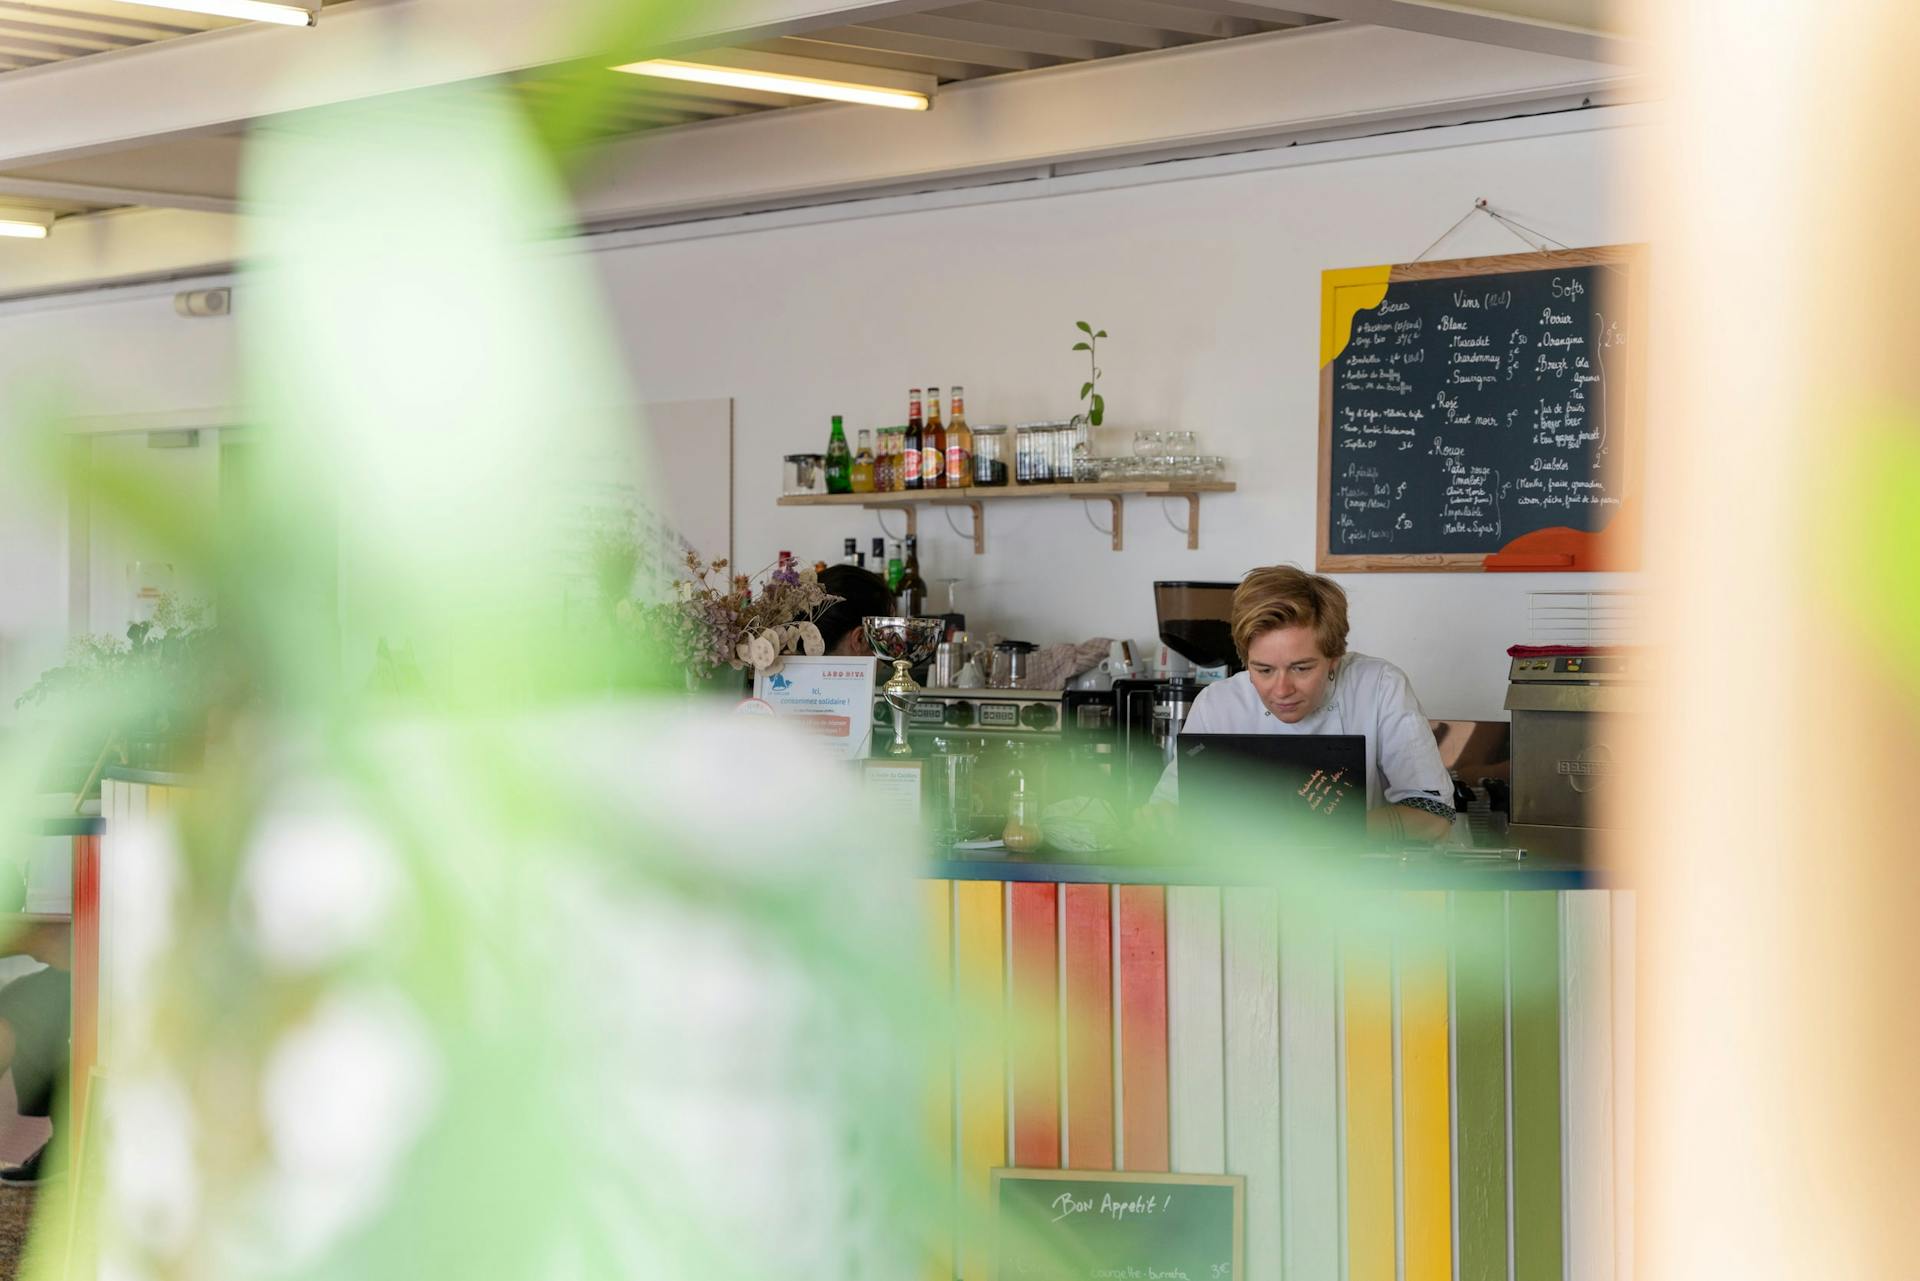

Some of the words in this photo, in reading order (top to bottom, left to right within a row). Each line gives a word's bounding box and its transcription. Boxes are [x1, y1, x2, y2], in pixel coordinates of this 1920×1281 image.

[1453, 289, 1480, 309] Vins
[1552, 277, 1585, 303] Softs
[1441, 315, 1468, 331] Blanc
[1542, 307, 1573, 325] Perrier
[1453, 335, 1490, 347] Muscadet
[1543, 331, 1585, 351] Orangina
[1453, 352, 1501, 370] Chardonnay
[1575, 357, 1590, 369] Cola
[1452, 369, 1497, 391] Sauvignon
[1436, 390, 1459, 409] Rosé
[1570, 387, 1585, 400] Tea
[1447, 408, 1471, 423] Pinot
[1475, 416, 1498, 426] noir
[1553, 403, 1563, 413] de
[1565, 401, 1585, 417] fruits
[1433, 436, 1465, 466] Rouge
[1533, 457, 1569, 471] Diabolos
[818, 698, 846, 706] solidaire
[1161, 1194, 1172, 1213] !
